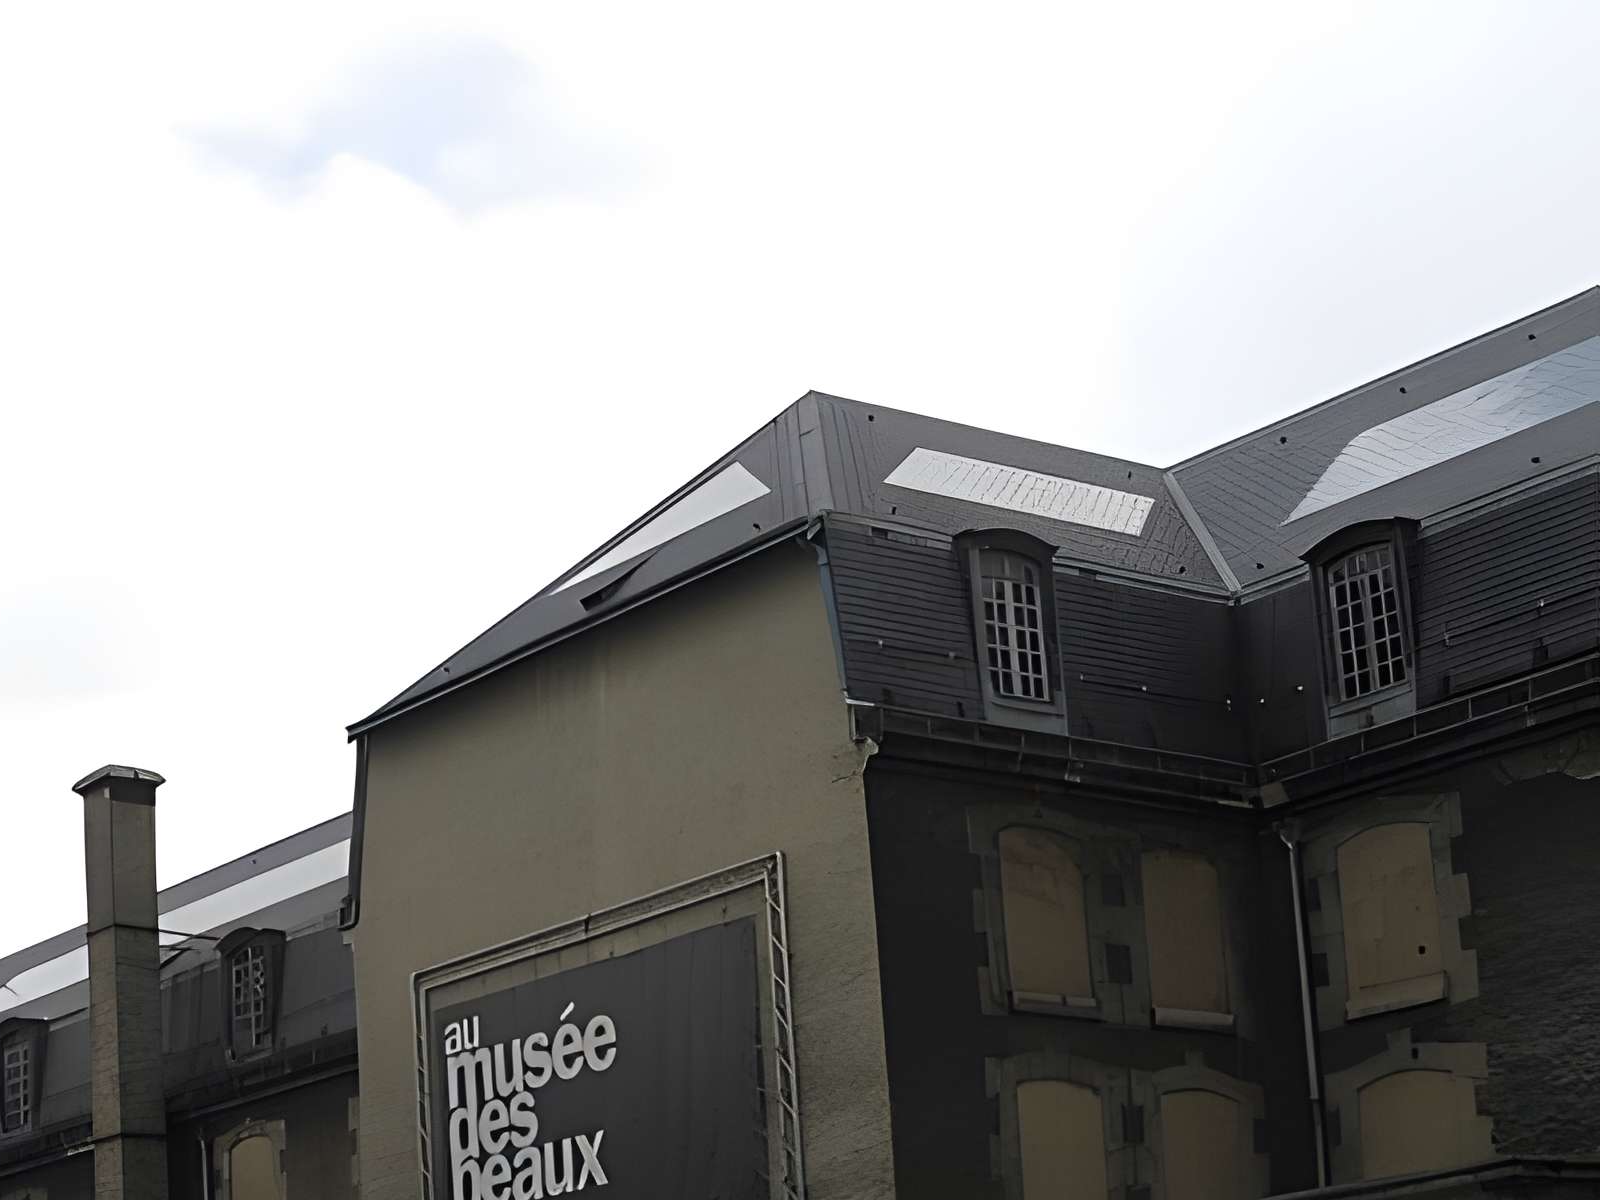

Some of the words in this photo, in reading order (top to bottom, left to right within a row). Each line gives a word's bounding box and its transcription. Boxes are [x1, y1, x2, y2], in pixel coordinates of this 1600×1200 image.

[445, 1016, 479, 1055] au
[447, 1001, 616, 1110] musée
[450, 1091, 538, 1159] des
